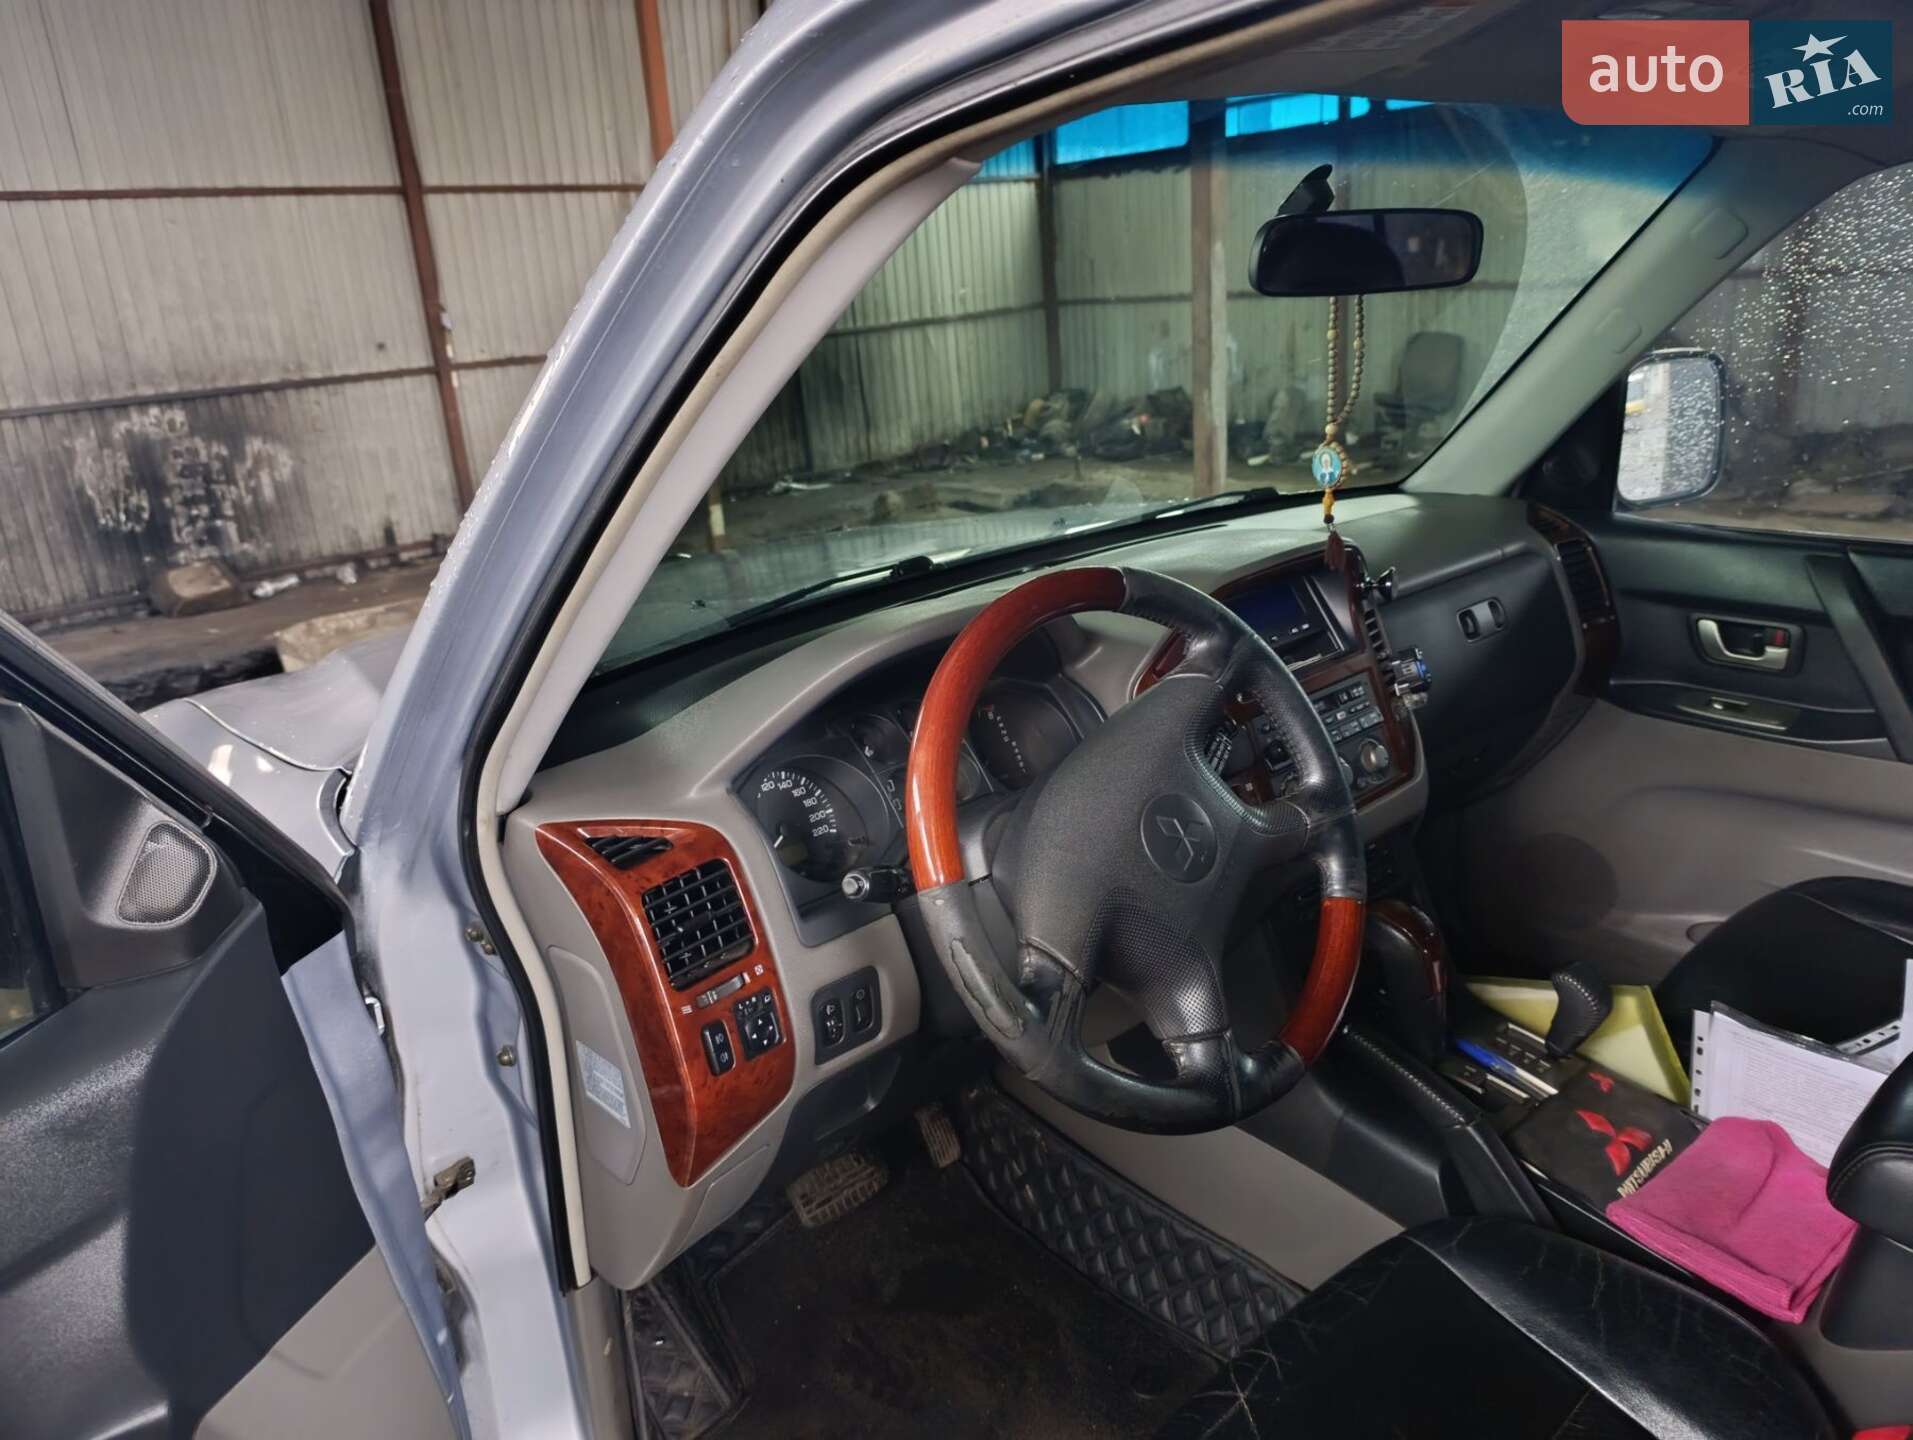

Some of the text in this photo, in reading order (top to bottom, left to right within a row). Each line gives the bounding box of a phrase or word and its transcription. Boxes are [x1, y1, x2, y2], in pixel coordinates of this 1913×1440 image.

[809, 810, 826, 822] 200
[812, 824, 829, 837] 220
[1616, 1138, 1673, 1198] MITSUBISHI
